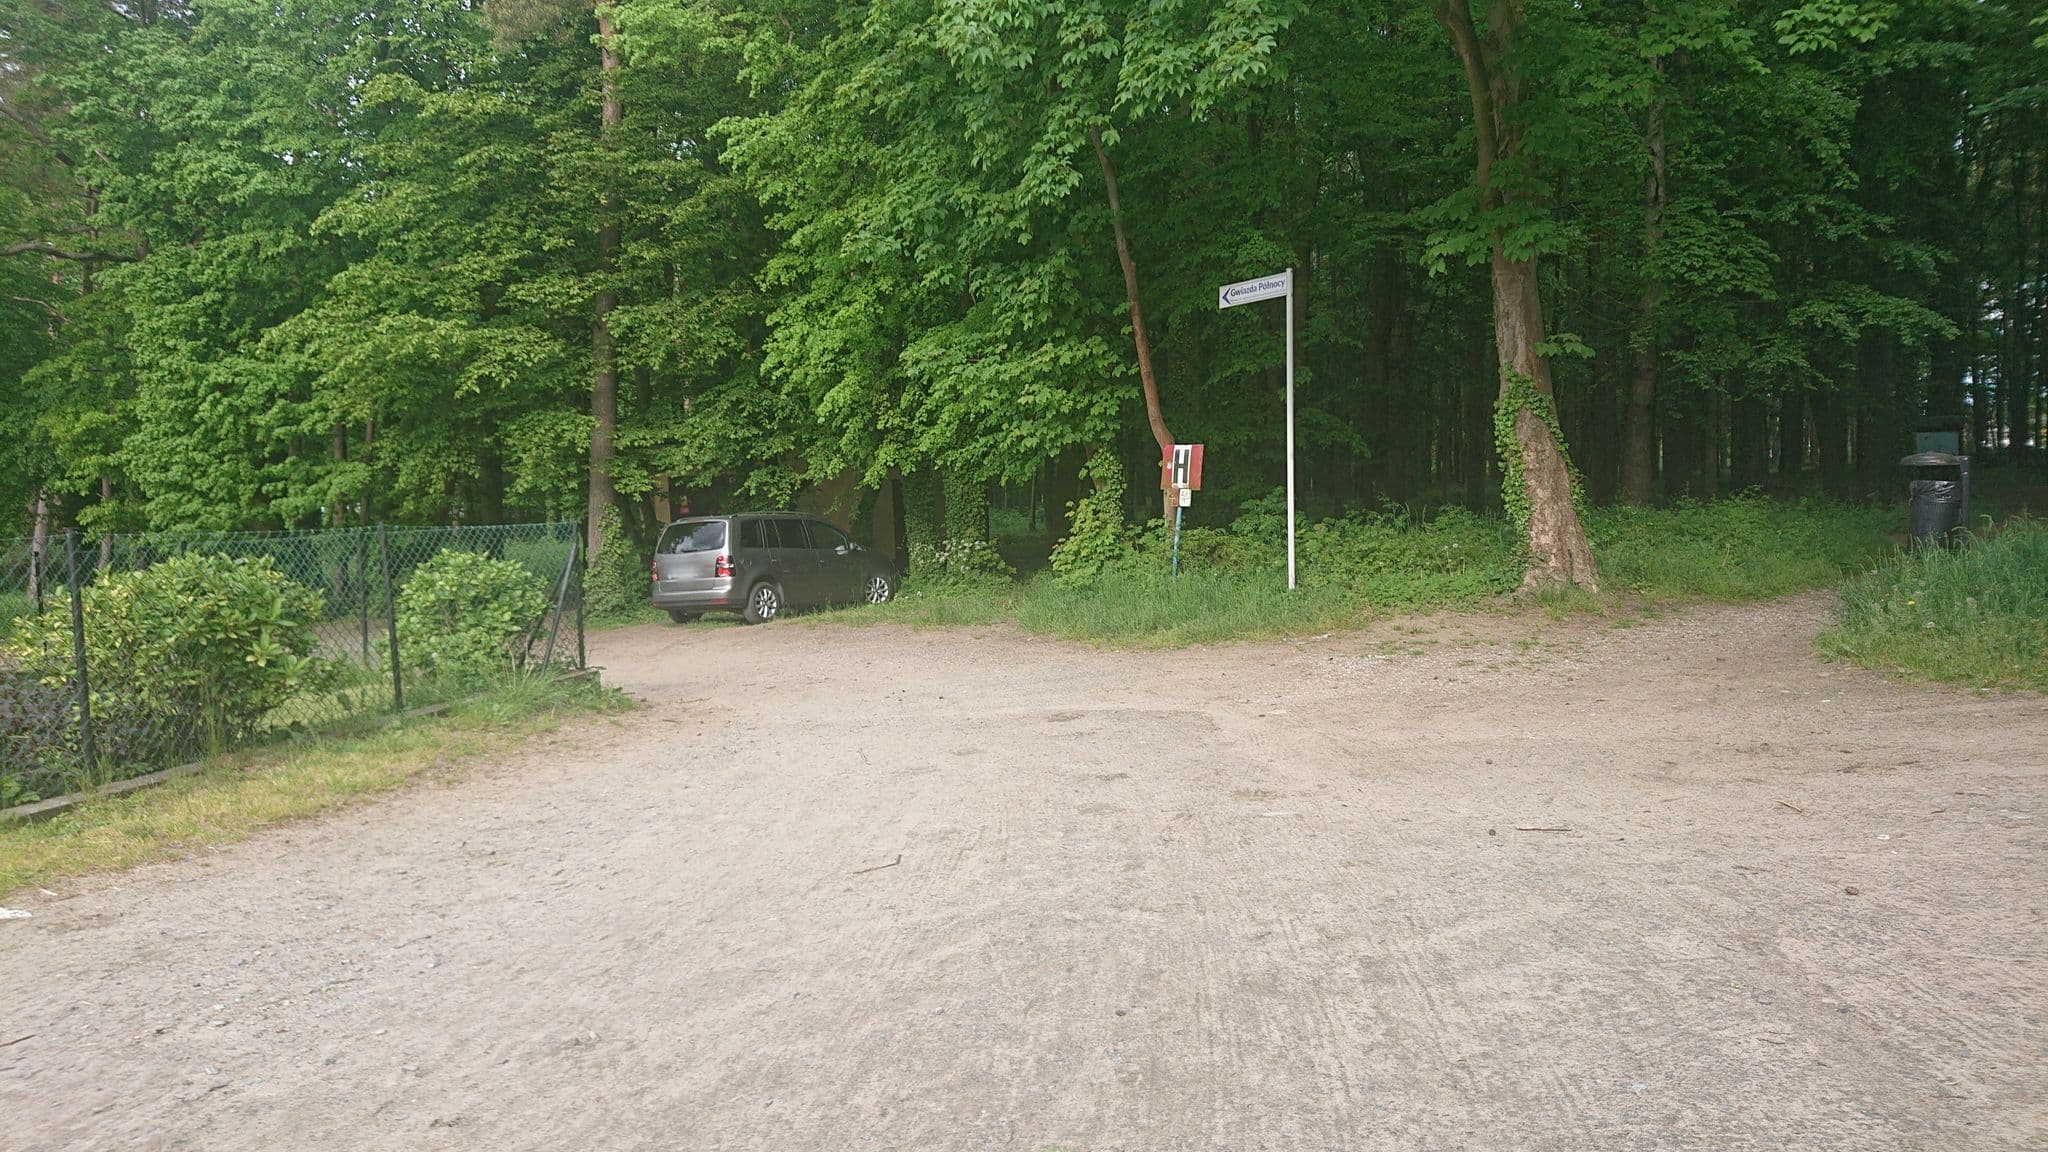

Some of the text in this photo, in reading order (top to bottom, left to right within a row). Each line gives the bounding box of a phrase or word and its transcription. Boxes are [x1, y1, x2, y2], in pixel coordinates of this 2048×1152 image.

[1230, 284, 1257, 297] Gwiazda
[1258, 279, 1285, 292] Północy
[1173, 449, 1190, 483] H
